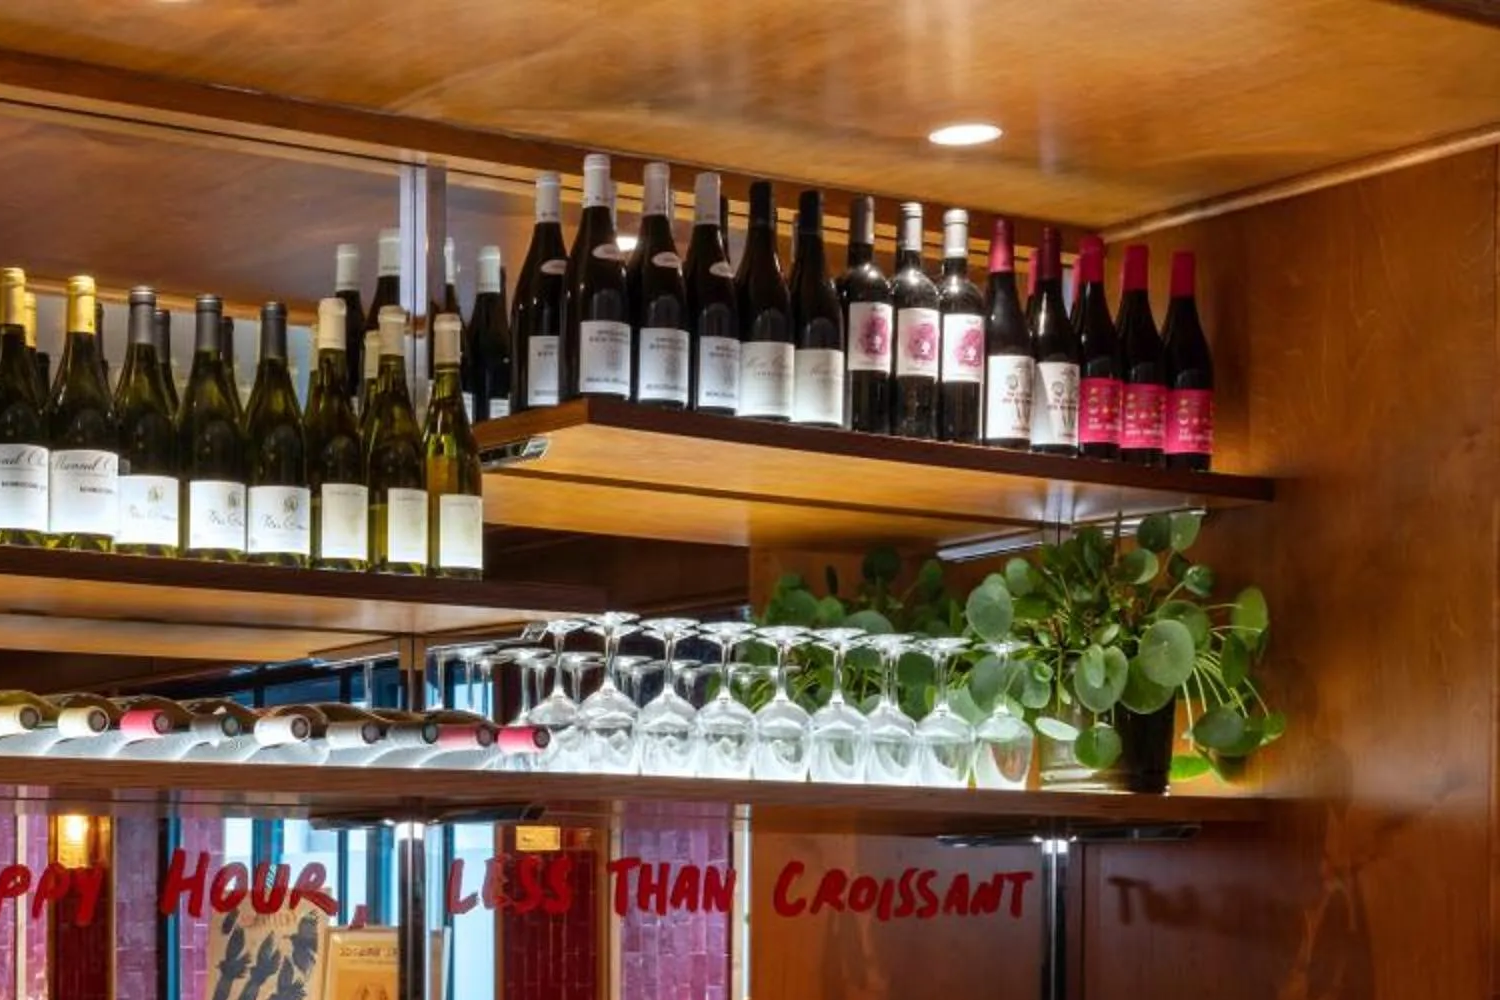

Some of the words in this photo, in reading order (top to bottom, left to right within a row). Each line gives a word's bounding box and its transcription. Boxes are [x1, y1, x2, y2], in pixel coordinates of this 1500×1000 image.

[445, 854, 573, 916] LESS
[607, 856, 736, 918] THAN
[773, 860, 1033, 922] CROISSANT
